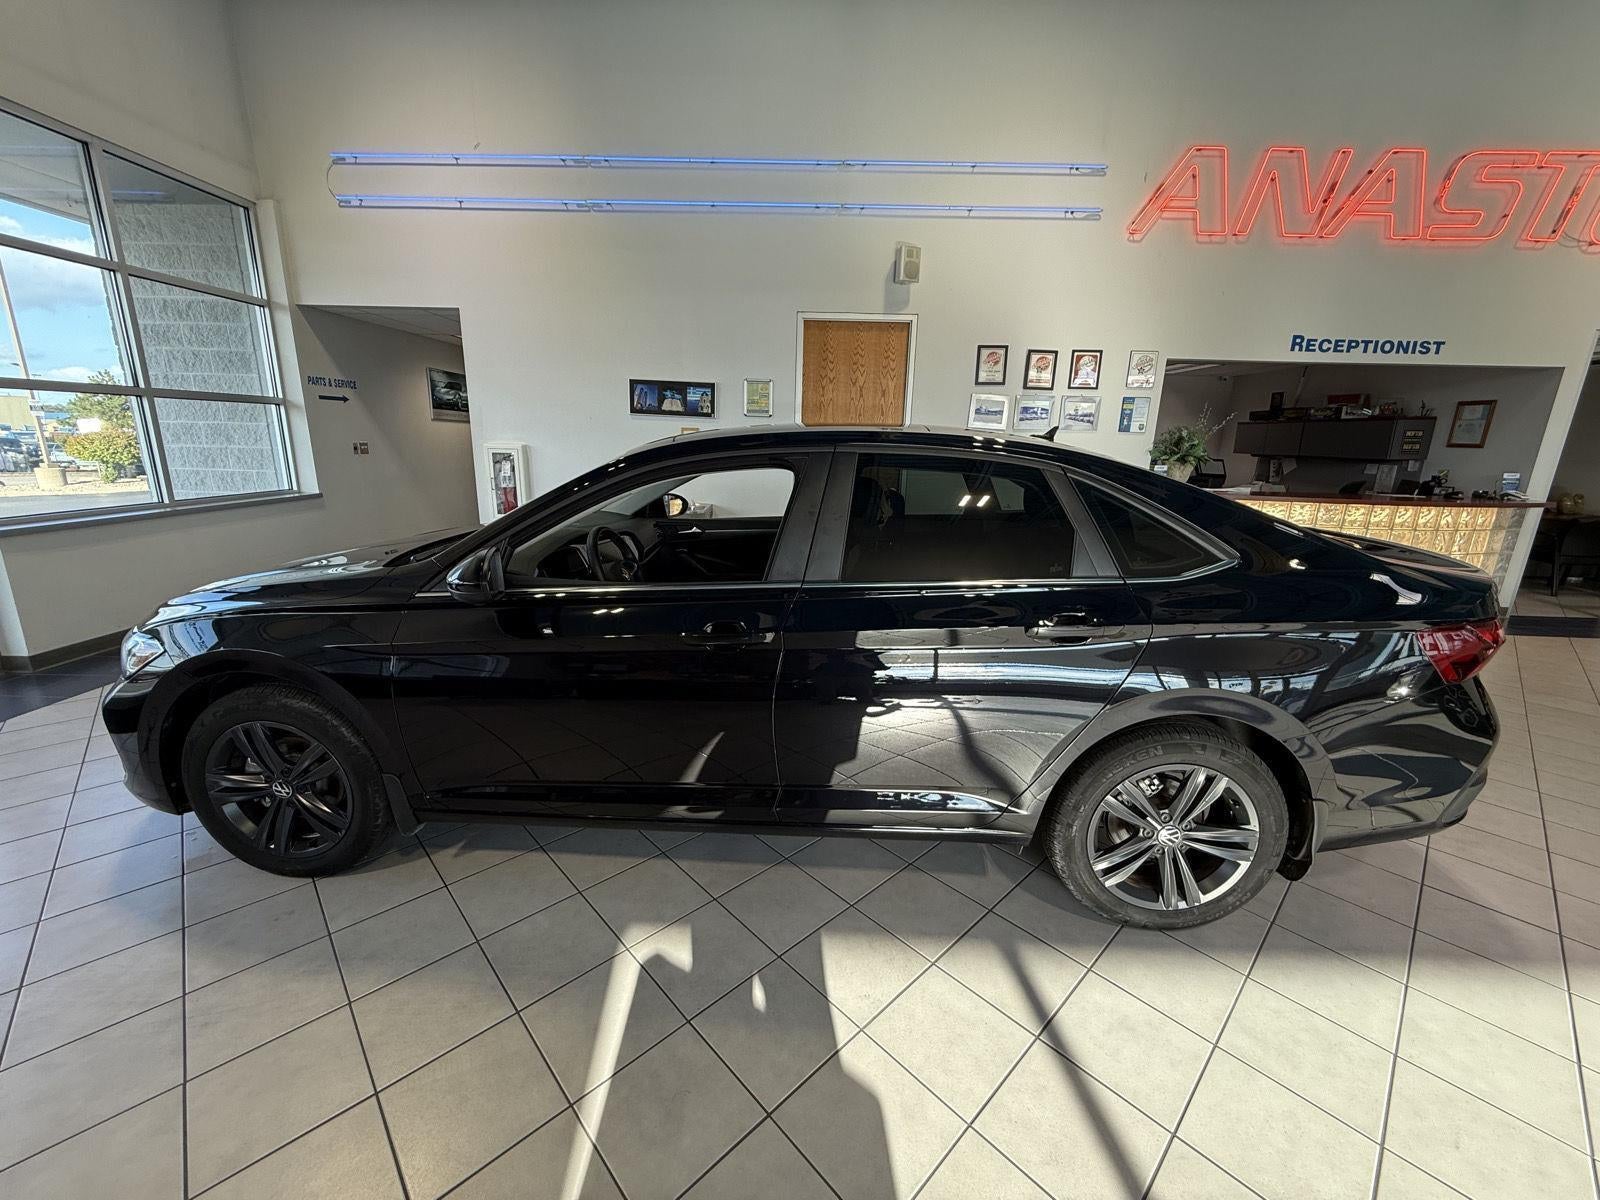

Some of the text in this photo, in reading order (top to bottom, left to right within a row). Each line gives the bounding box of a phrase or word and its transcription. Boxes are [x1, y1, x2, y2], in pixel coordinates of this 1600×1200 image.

[1289, 334, 1446, 355] RECEPTIONIST
[307, 375, 358, 390] PARTS & SERVICE
[1158, 825, 1181, 846] VW
